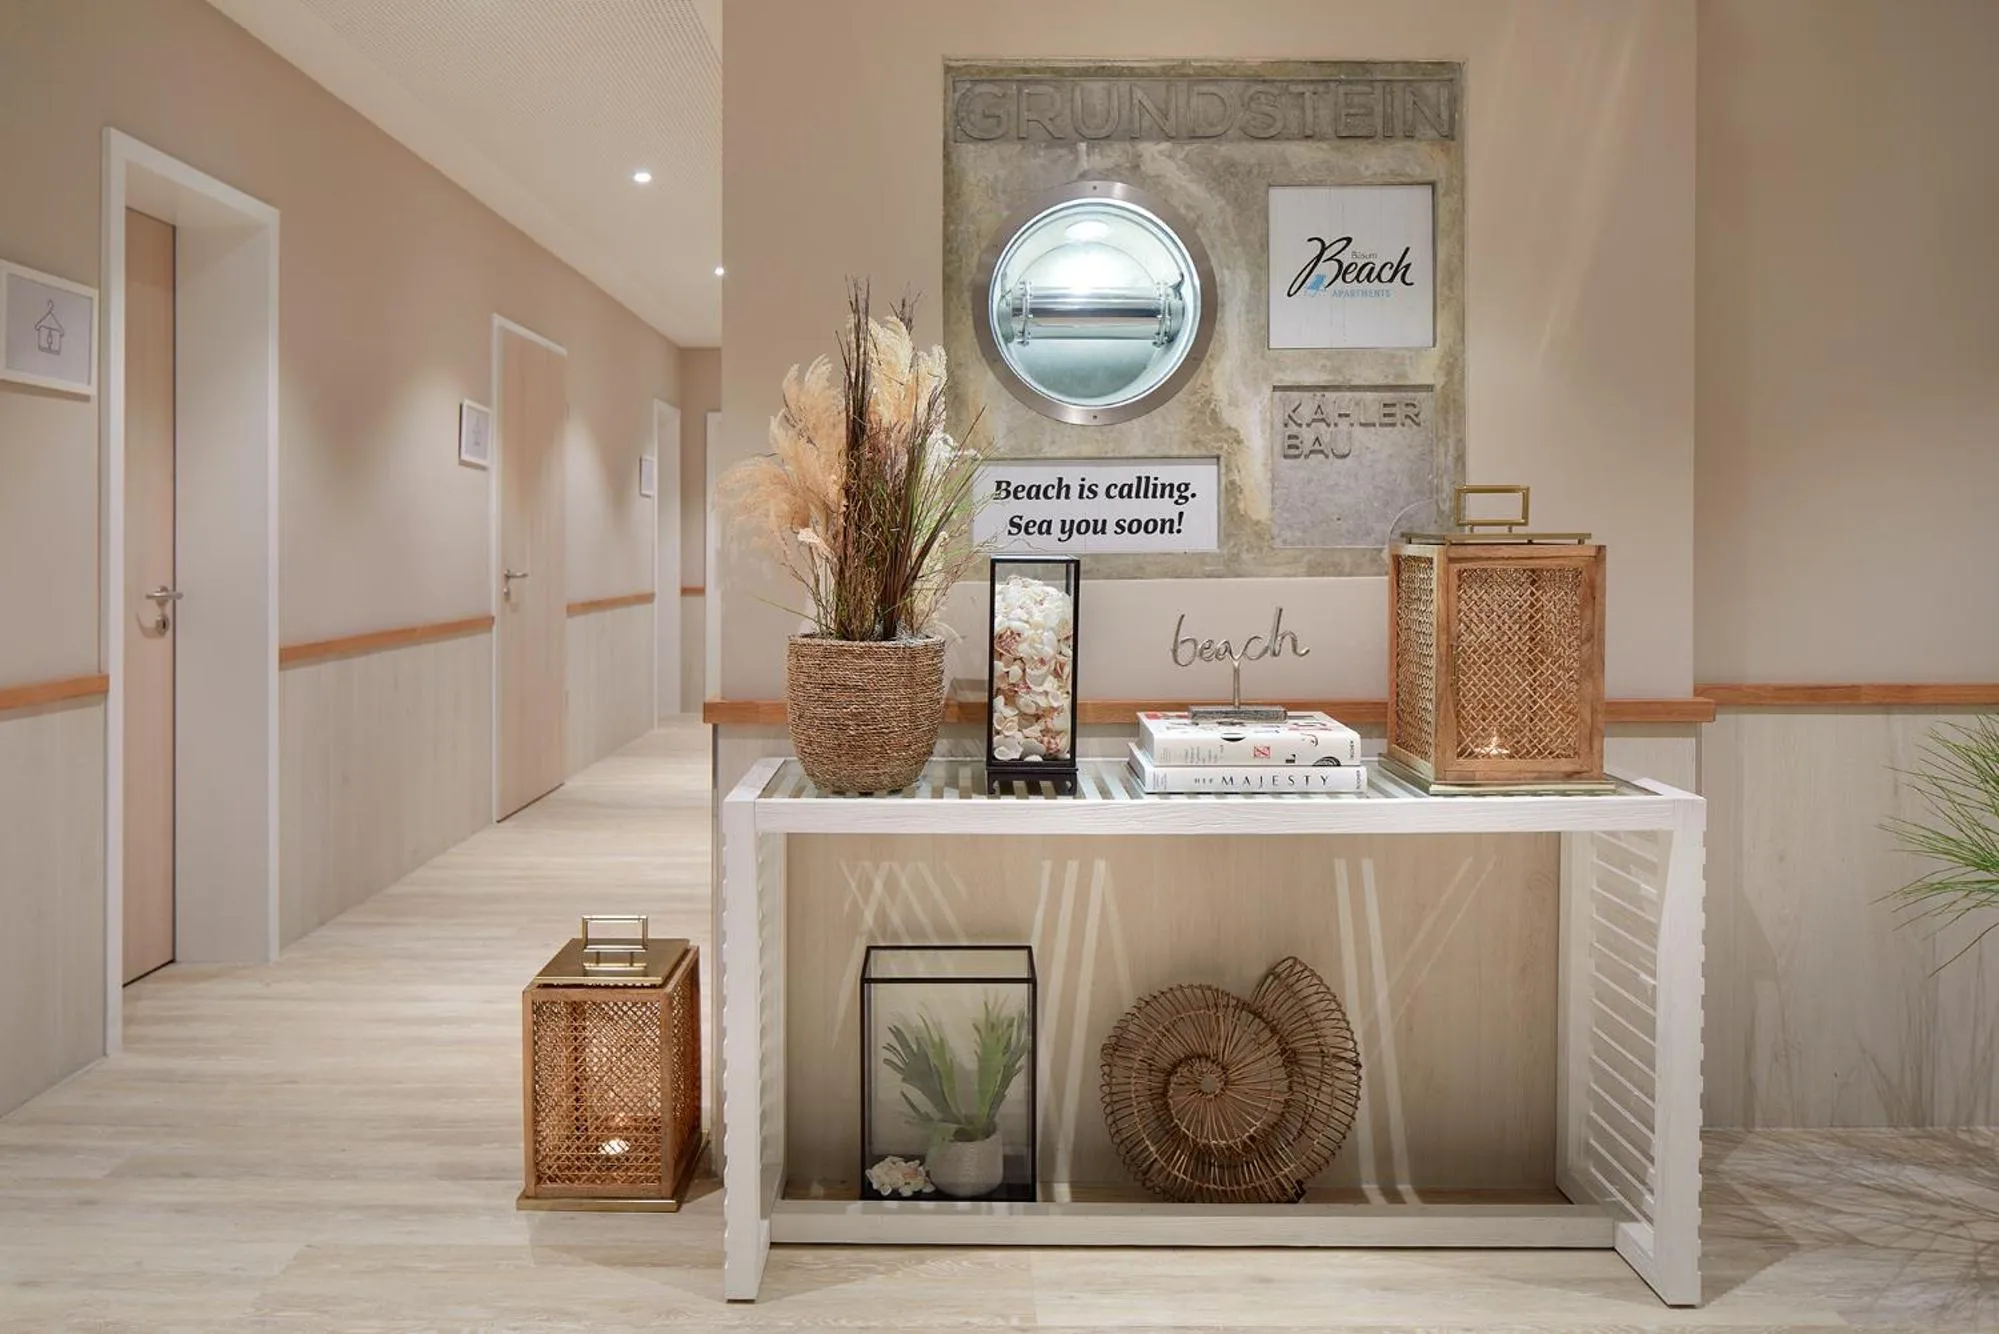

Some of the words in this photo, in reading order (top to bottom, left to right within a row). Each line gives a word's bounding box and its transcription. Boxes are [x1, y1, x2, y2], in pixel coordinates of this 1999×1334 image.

[957, 83, 1452, 141] GRUNDSTEIN
[1286, 236, 1416, 298] Beach
[1331, 288, 1393, 298] APARTMENTS
[1282, 393, 1423, 428] KÄHLER
[1282, 431, 1352, 460] BAU
[993, 476, 1072, 501] Beach
[1077, 477, 1100, 501] is
[1104, 475, 1198, 506] calling.
[1007, 514, 1053, 537] Sea
[1057, 517, 1108, 542] you
[1113, 511, 1186, 536] soon!
[1172, 607, 1311, 668] beach
[1220, 775, 1329, 789] MAJESTY
